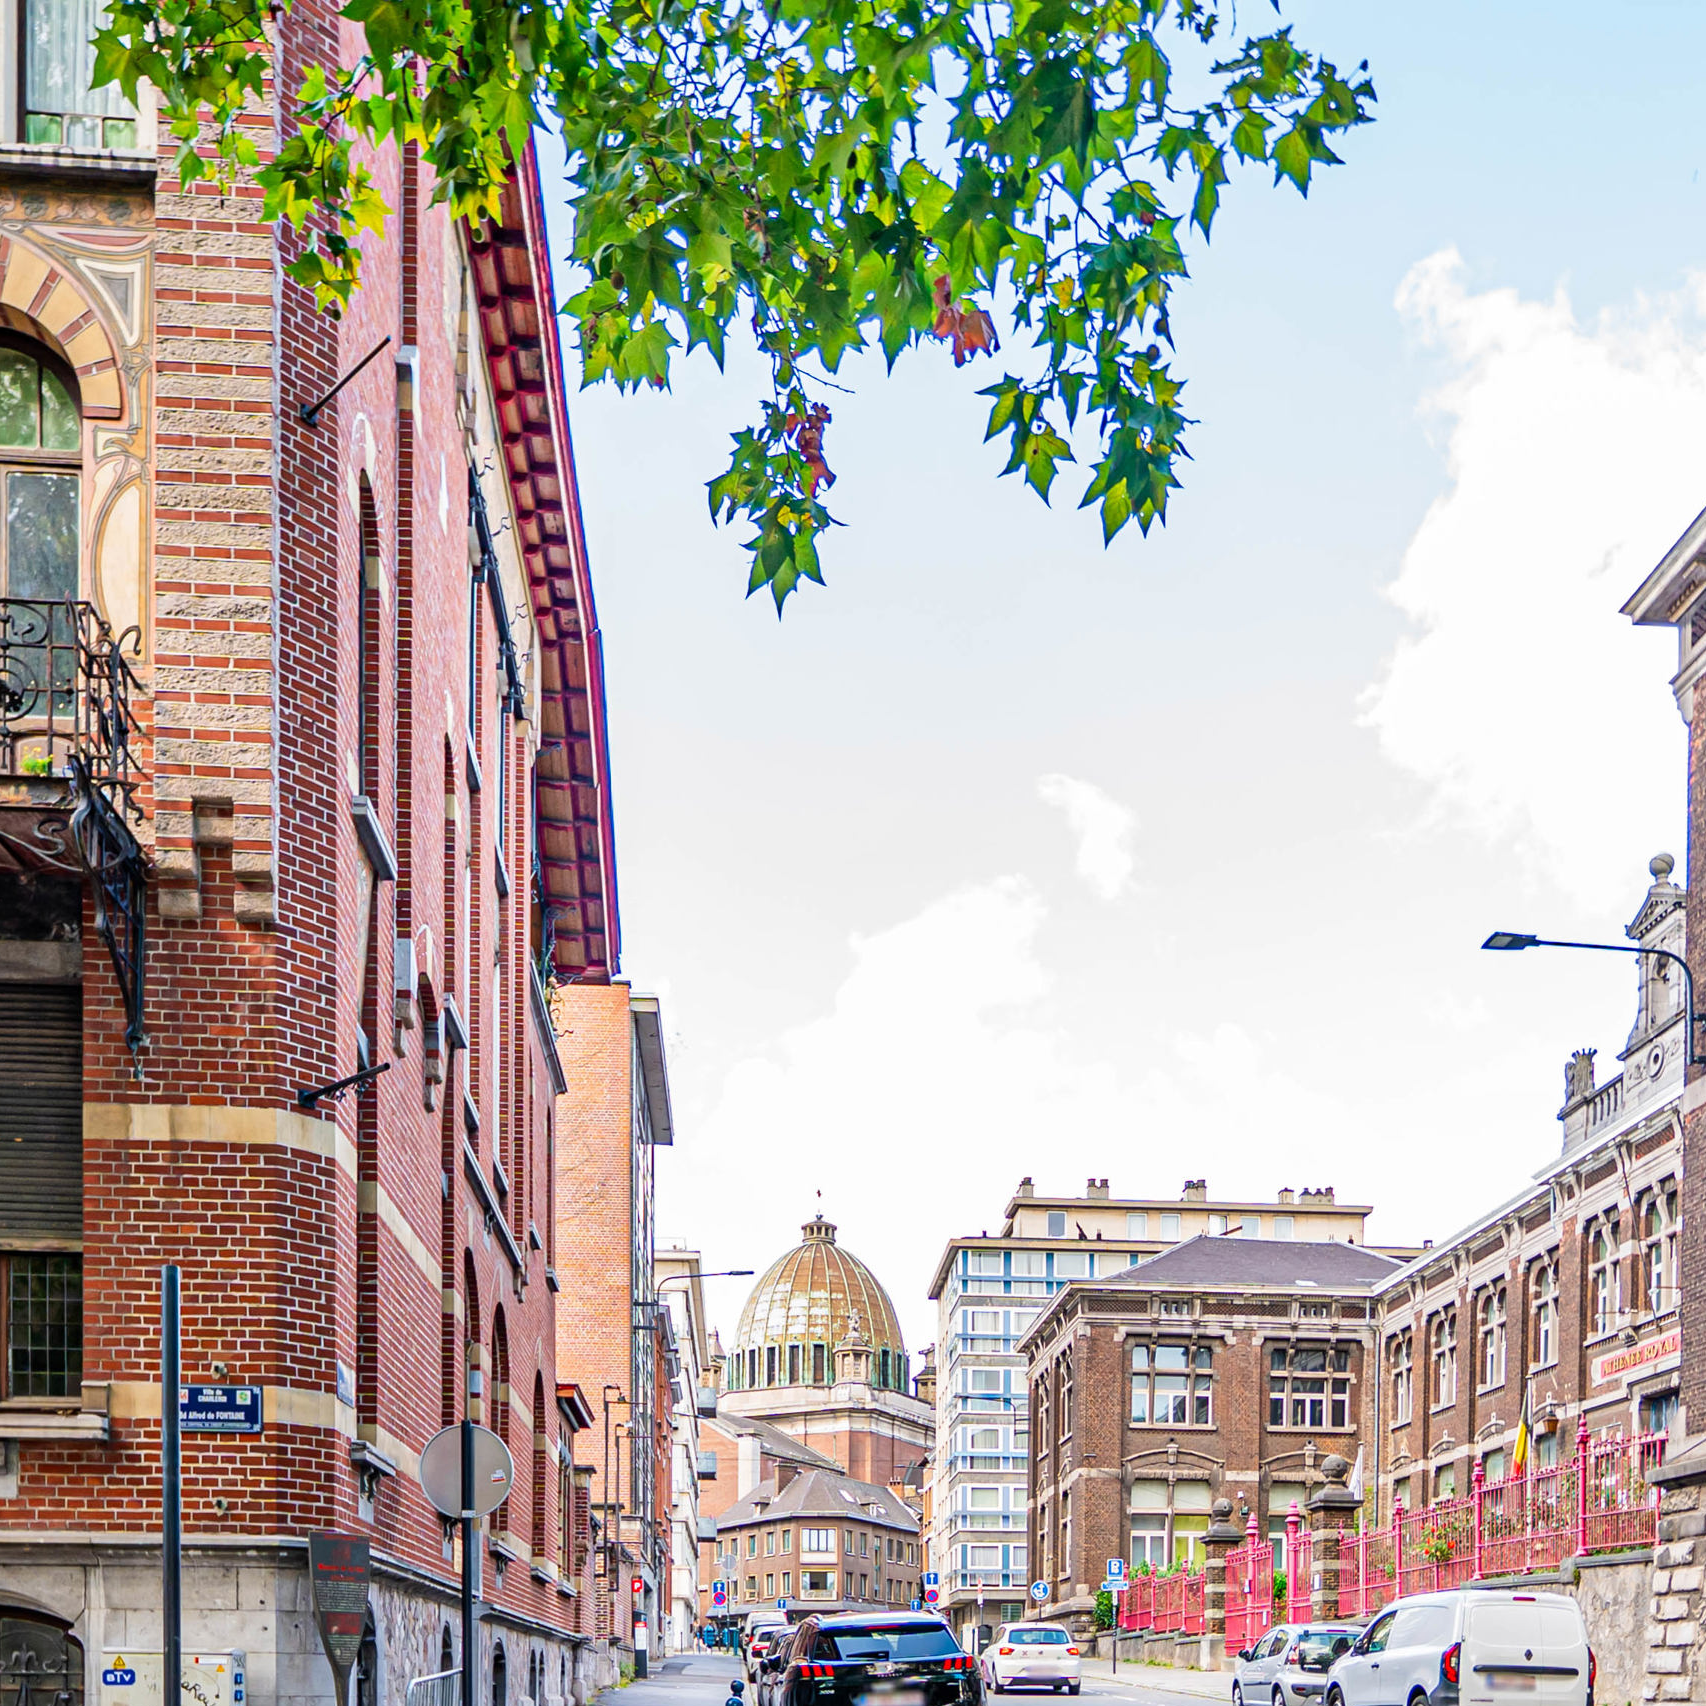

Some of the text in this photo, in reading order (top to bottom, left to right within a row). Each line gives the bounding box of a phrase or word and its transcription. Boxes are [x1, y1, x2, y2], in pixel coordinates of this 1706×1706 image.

[1644, 1337, 1677, 1361] ROYAL
[188, 1411, 206, 1420] Alfred
[207, 1411, 215, 1420] de
[216, 1411, 245, 1420] FONTAINE
